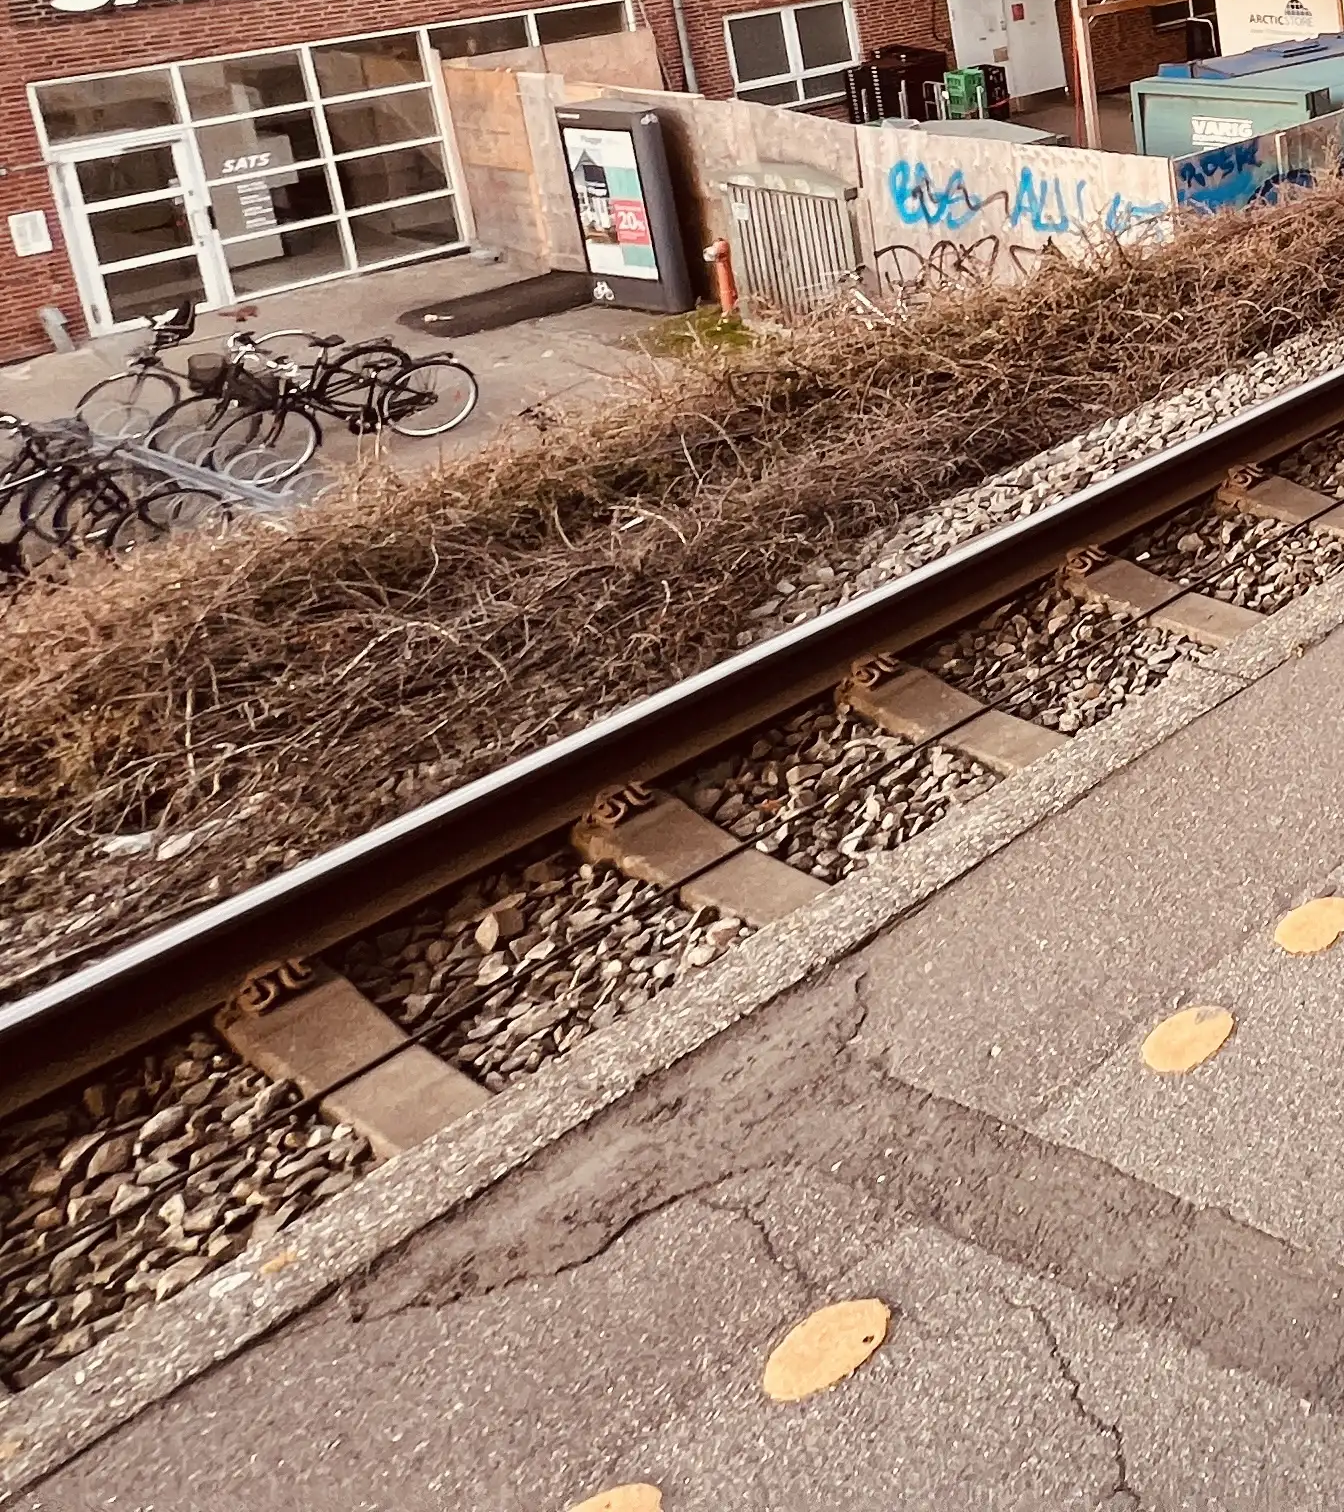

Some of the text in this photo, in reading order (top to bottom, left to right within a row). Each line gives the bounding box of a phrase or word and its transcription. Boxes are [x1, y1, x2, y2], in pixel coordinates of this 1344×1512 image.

[1191, 120, 1253, 138] VARIG
[222, 152, 272, 174] SATS
[617, 211, 646, 232] 20%
